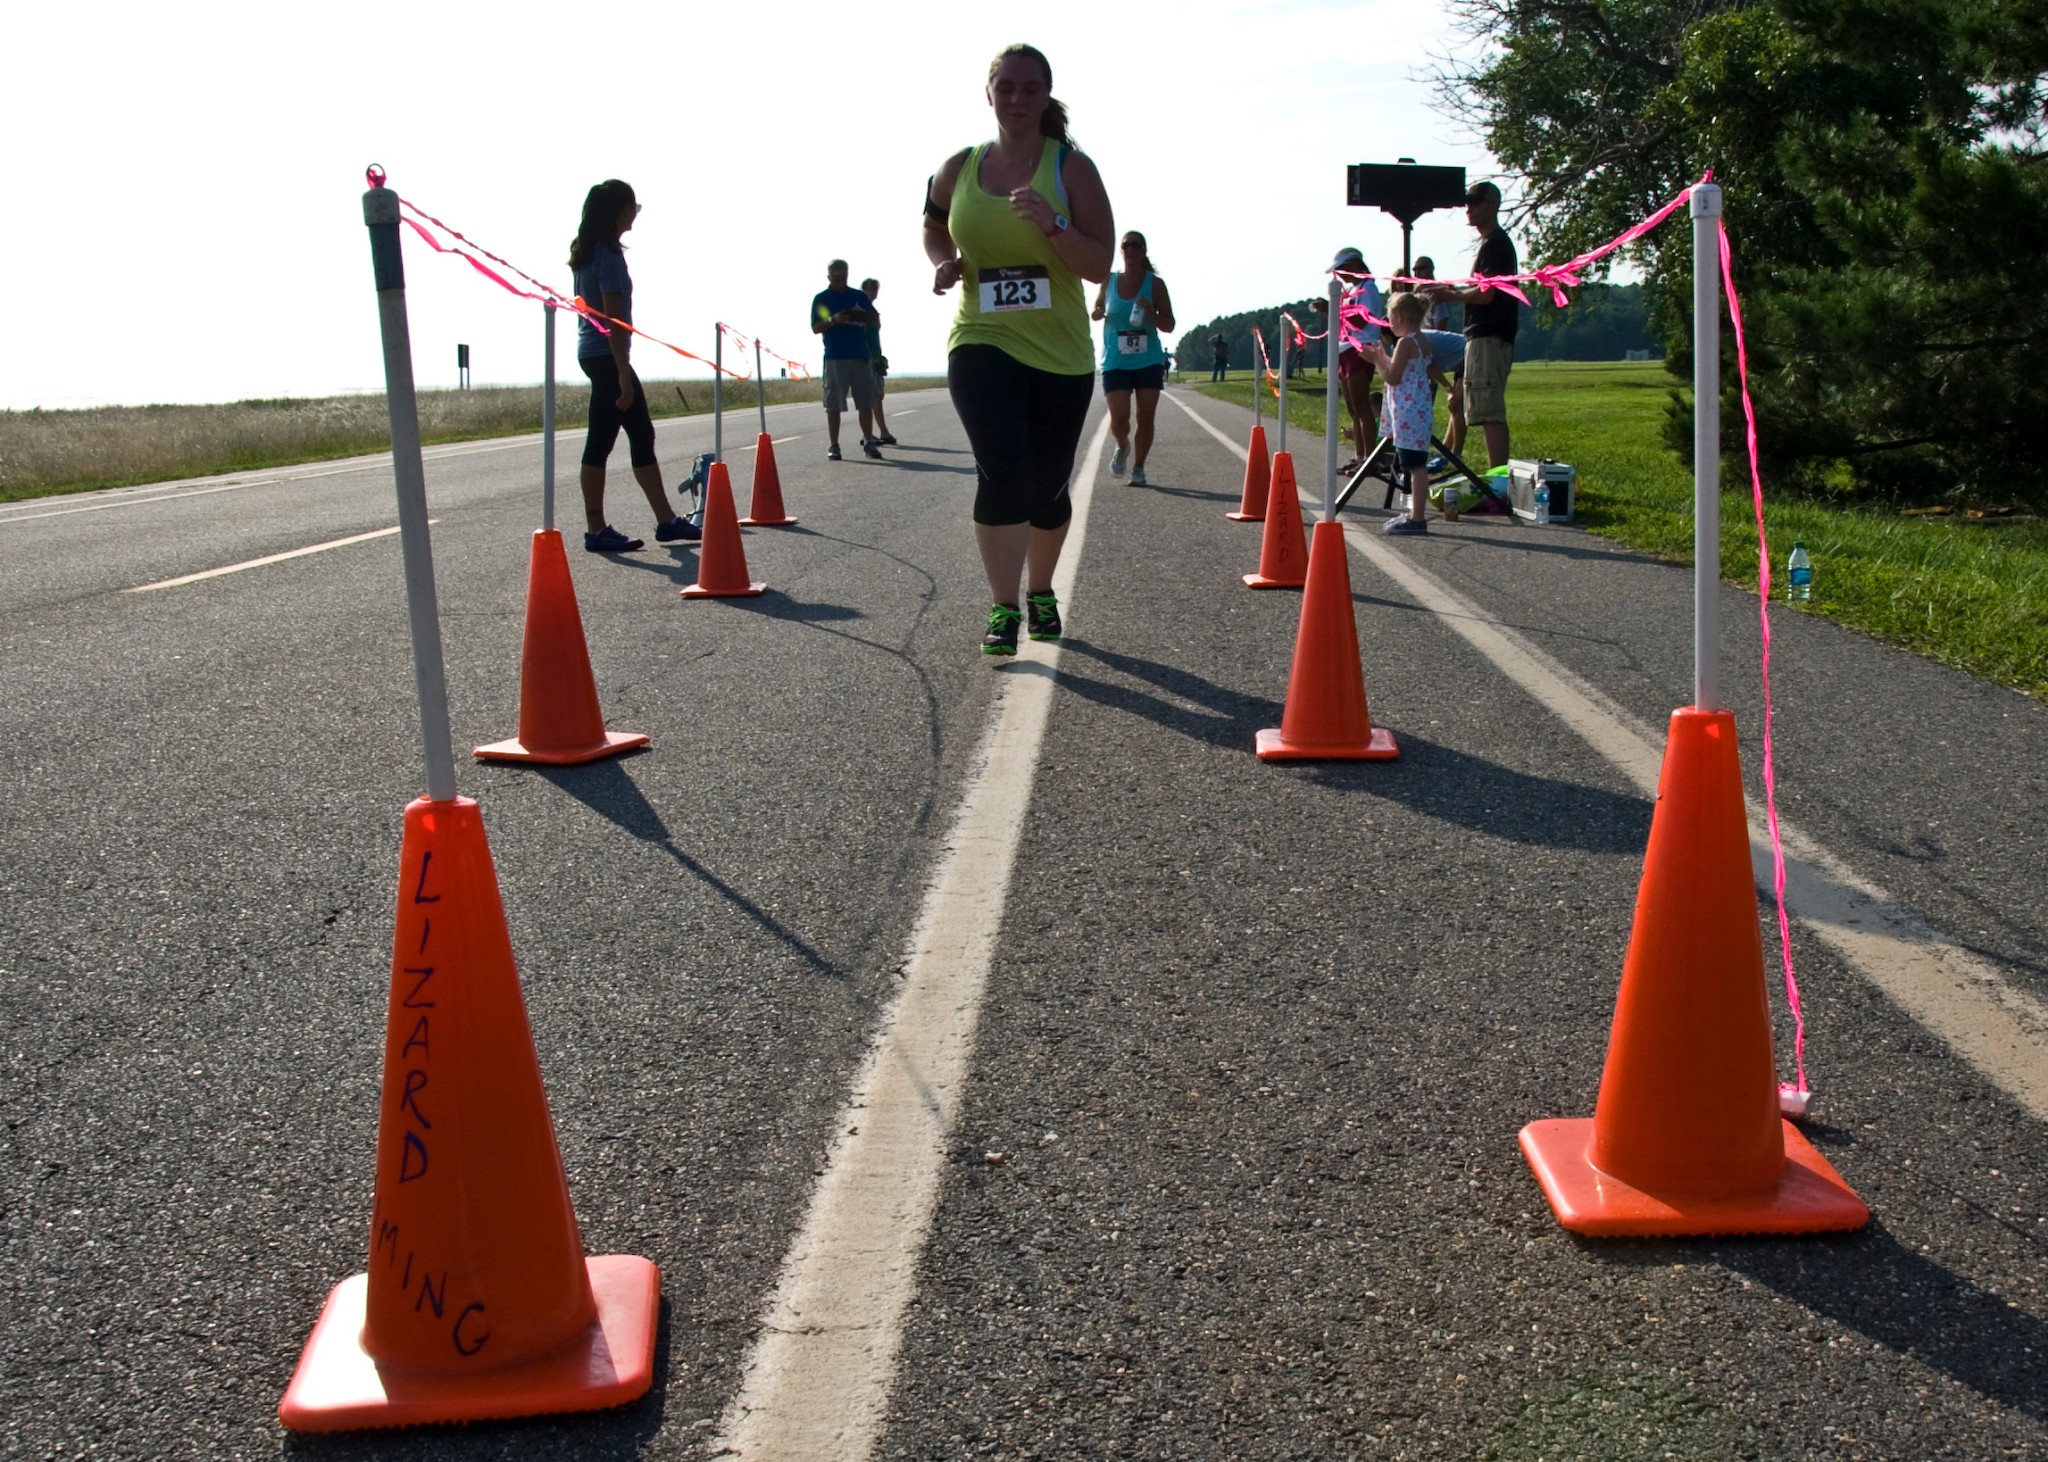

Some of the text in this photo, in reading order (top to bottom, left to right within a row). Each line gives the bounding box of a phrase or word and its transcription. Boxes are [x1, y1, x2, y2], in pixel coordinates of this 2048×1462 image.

[993, 280, 1037, 307] 123
[1127, 335, 1140, 347] 87
[399, 851, 441, 1183] LIZARD
